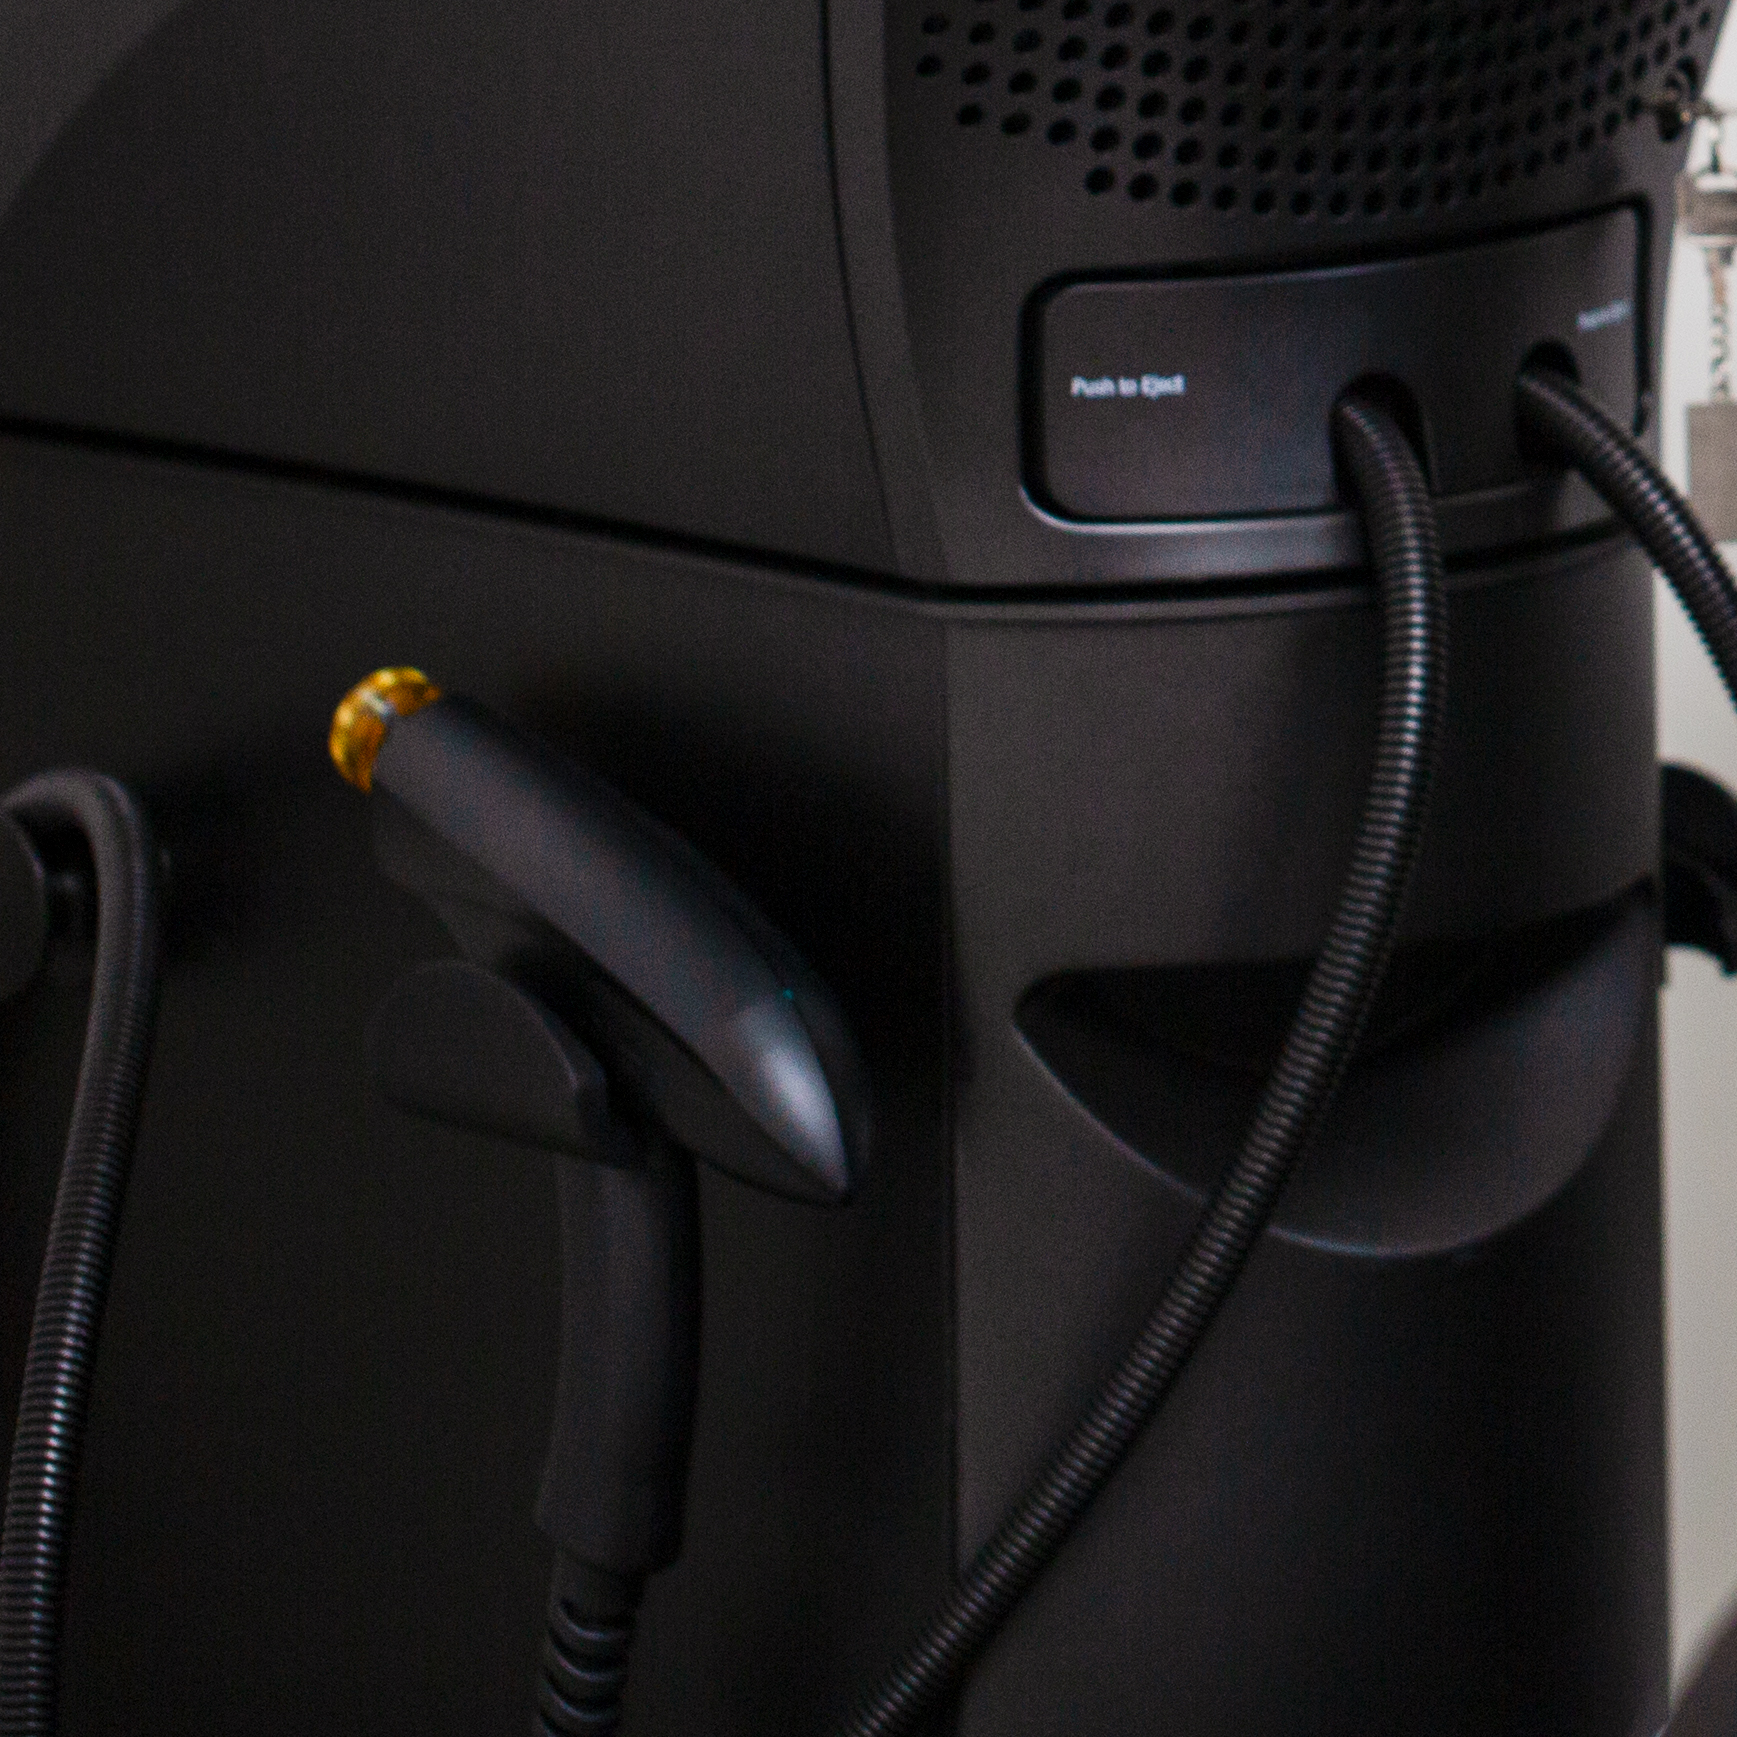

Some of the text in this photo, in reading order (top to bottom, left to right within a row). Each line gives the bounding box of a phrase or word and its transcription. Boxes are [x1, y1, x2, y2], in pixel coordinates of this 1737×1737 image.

[1070, 372, 1187, 401] Push to Eject
